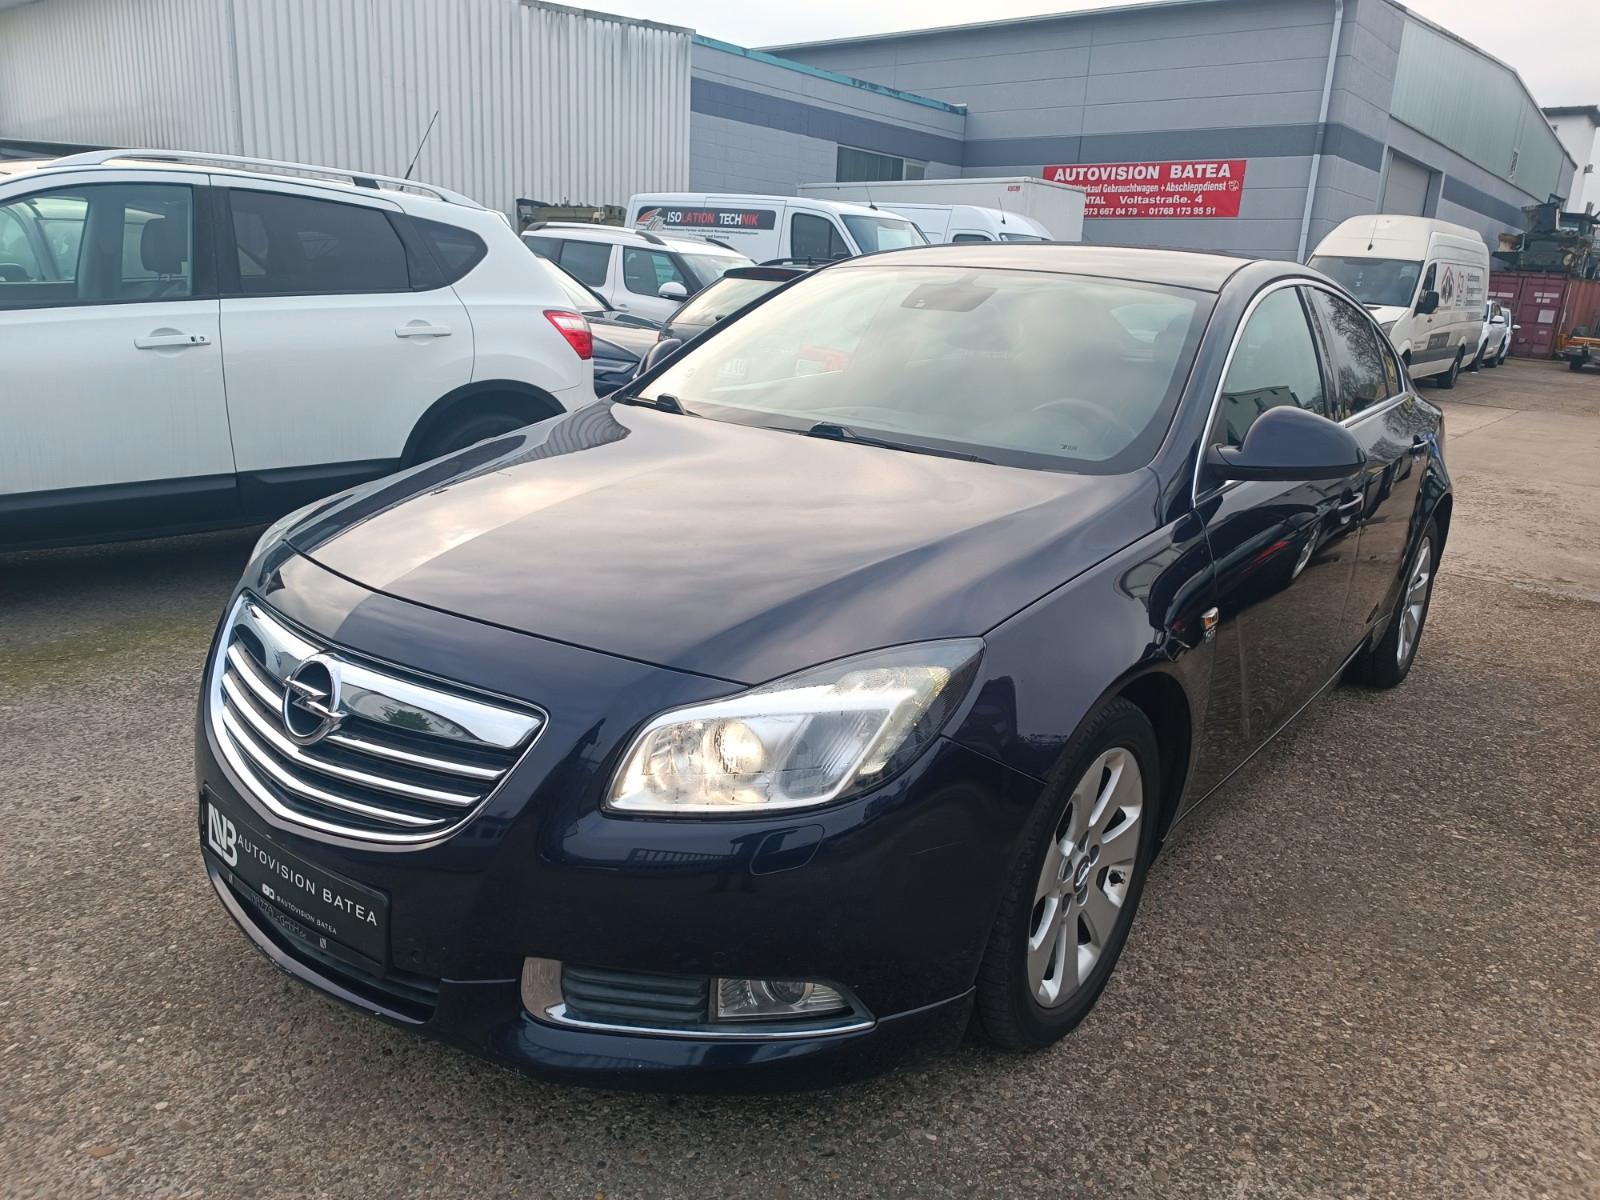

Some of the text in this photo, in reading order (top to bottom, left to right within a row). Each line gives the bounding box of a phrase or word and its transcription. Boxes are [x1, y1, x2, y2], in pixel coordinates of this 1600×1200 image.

[1053, 163, 1231, 182] AUTOVISION BATEA
[1102, 182, 1159, 195] Gebrauchtwagen
[1165, 180, 1227, 194] Abschleppdienst
[1084, 195, 1106, 205] NTAL
[1194, 194, 1204, 204] 4
[666, 211, 759, 226] ISOLATION TECHNIK
[1084, 207, 1098, 216] 573
[1099, 207, 1114, 216] 667
[1115, 207, 1126, 216] 04
[1127, 206, 1138, 216] 79
[1148, 206, 1174, 216] 01768
[1175, 206, 1191, 216] 173
[1193, 206, 1204, 215] 95
[1205, 206, 1217, 215] 91
[237, 833, 316, 896] AUTOVISION
[322, 888, 378, 926] BATEA
[316, 919, 337, 936] BATEA
